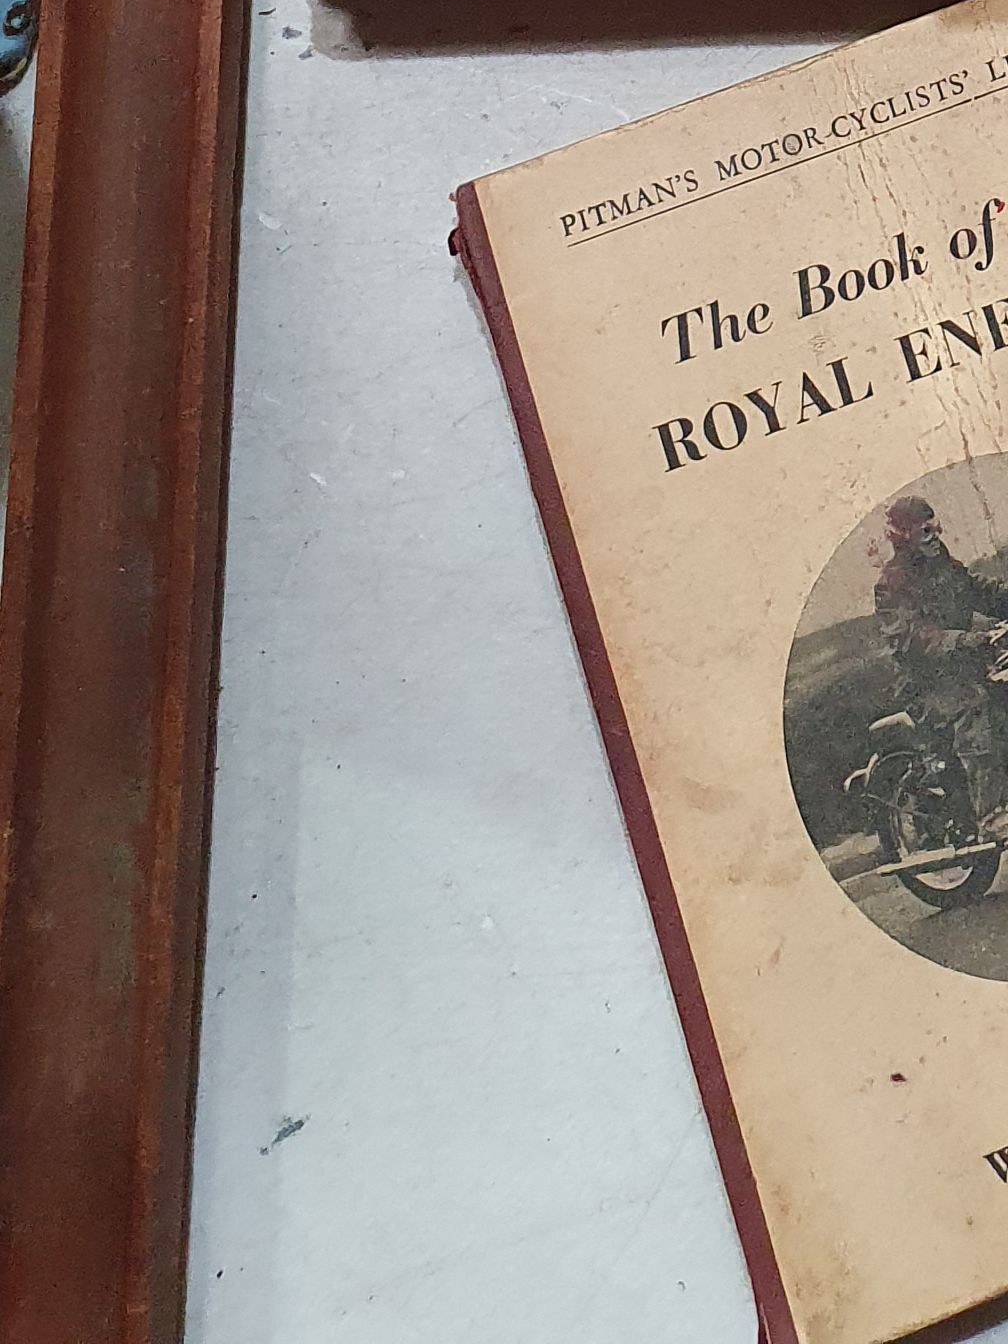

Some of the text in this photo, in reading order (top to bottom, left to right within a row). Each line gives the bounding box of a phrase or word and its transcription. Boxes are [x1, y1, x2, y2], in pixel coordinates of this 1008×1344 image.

[560, 169, 699, 237] PITMAN'S
[661, 298, 774, 365] The
[792, 233, 928, 319] Book
[950, 198, 1005, 271] of
[652, 356, 874, 473] ROYAL
